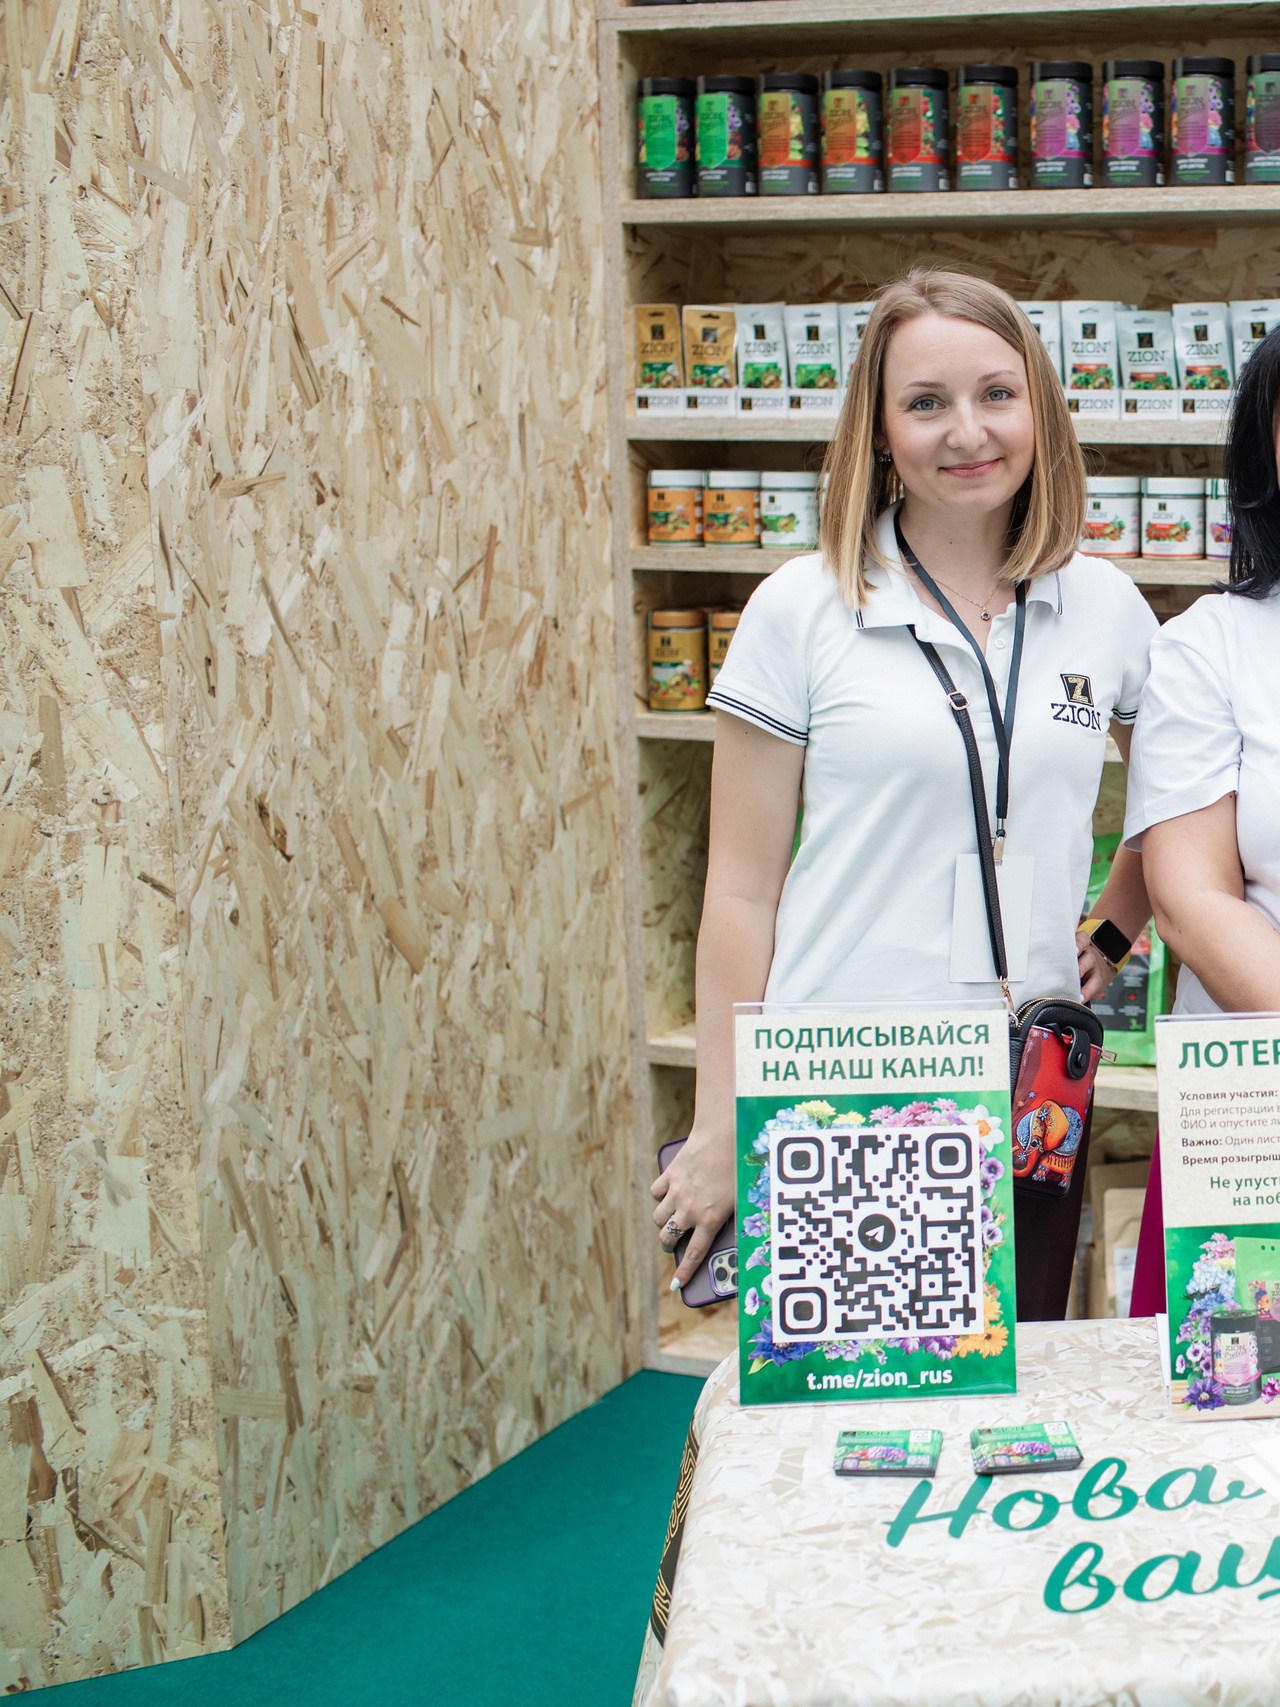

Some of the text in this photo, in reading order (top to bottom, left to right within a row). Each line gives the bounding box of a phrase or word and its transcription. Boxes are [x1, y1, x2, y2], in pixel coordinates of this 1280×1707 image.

[1128, 351, 1165, 363] ZION
[1080, 399, 1114, 410] ZION
[1137, 400, 1172, 410] ZION
[1051, 703, 1101, 731] ZION
[754, 1020, 990, 1053] ПОДПИСЫВАЙСЯ
[762, 1055, 984, 1081] НА НАШ КАНАЛ!
[1179, 1090, 1278, 1101] Условия участия:
[1180, 1106, 1201, 1118] Для
[1204, 1104, 1274, 1118] регистрации
[1180, 1119, 1207, 1130] ФИО
[1219, 1118, 1268, 1130] опустите
[1181, 1137, 1223, 1147] Важно:
[1224, 1135, 1255, 1147] Один
[1182, 1154, 1218, 1167] Время
[1210, 1176, 1231, 1189] Не
[1233, 1195, 1251, 1207] на
[1225, 1344, 1246, 1352] ZION
[806, 1367, 953, 1390] t.me/zion_rus
[882, 1457, 1266, 1548] Нова
